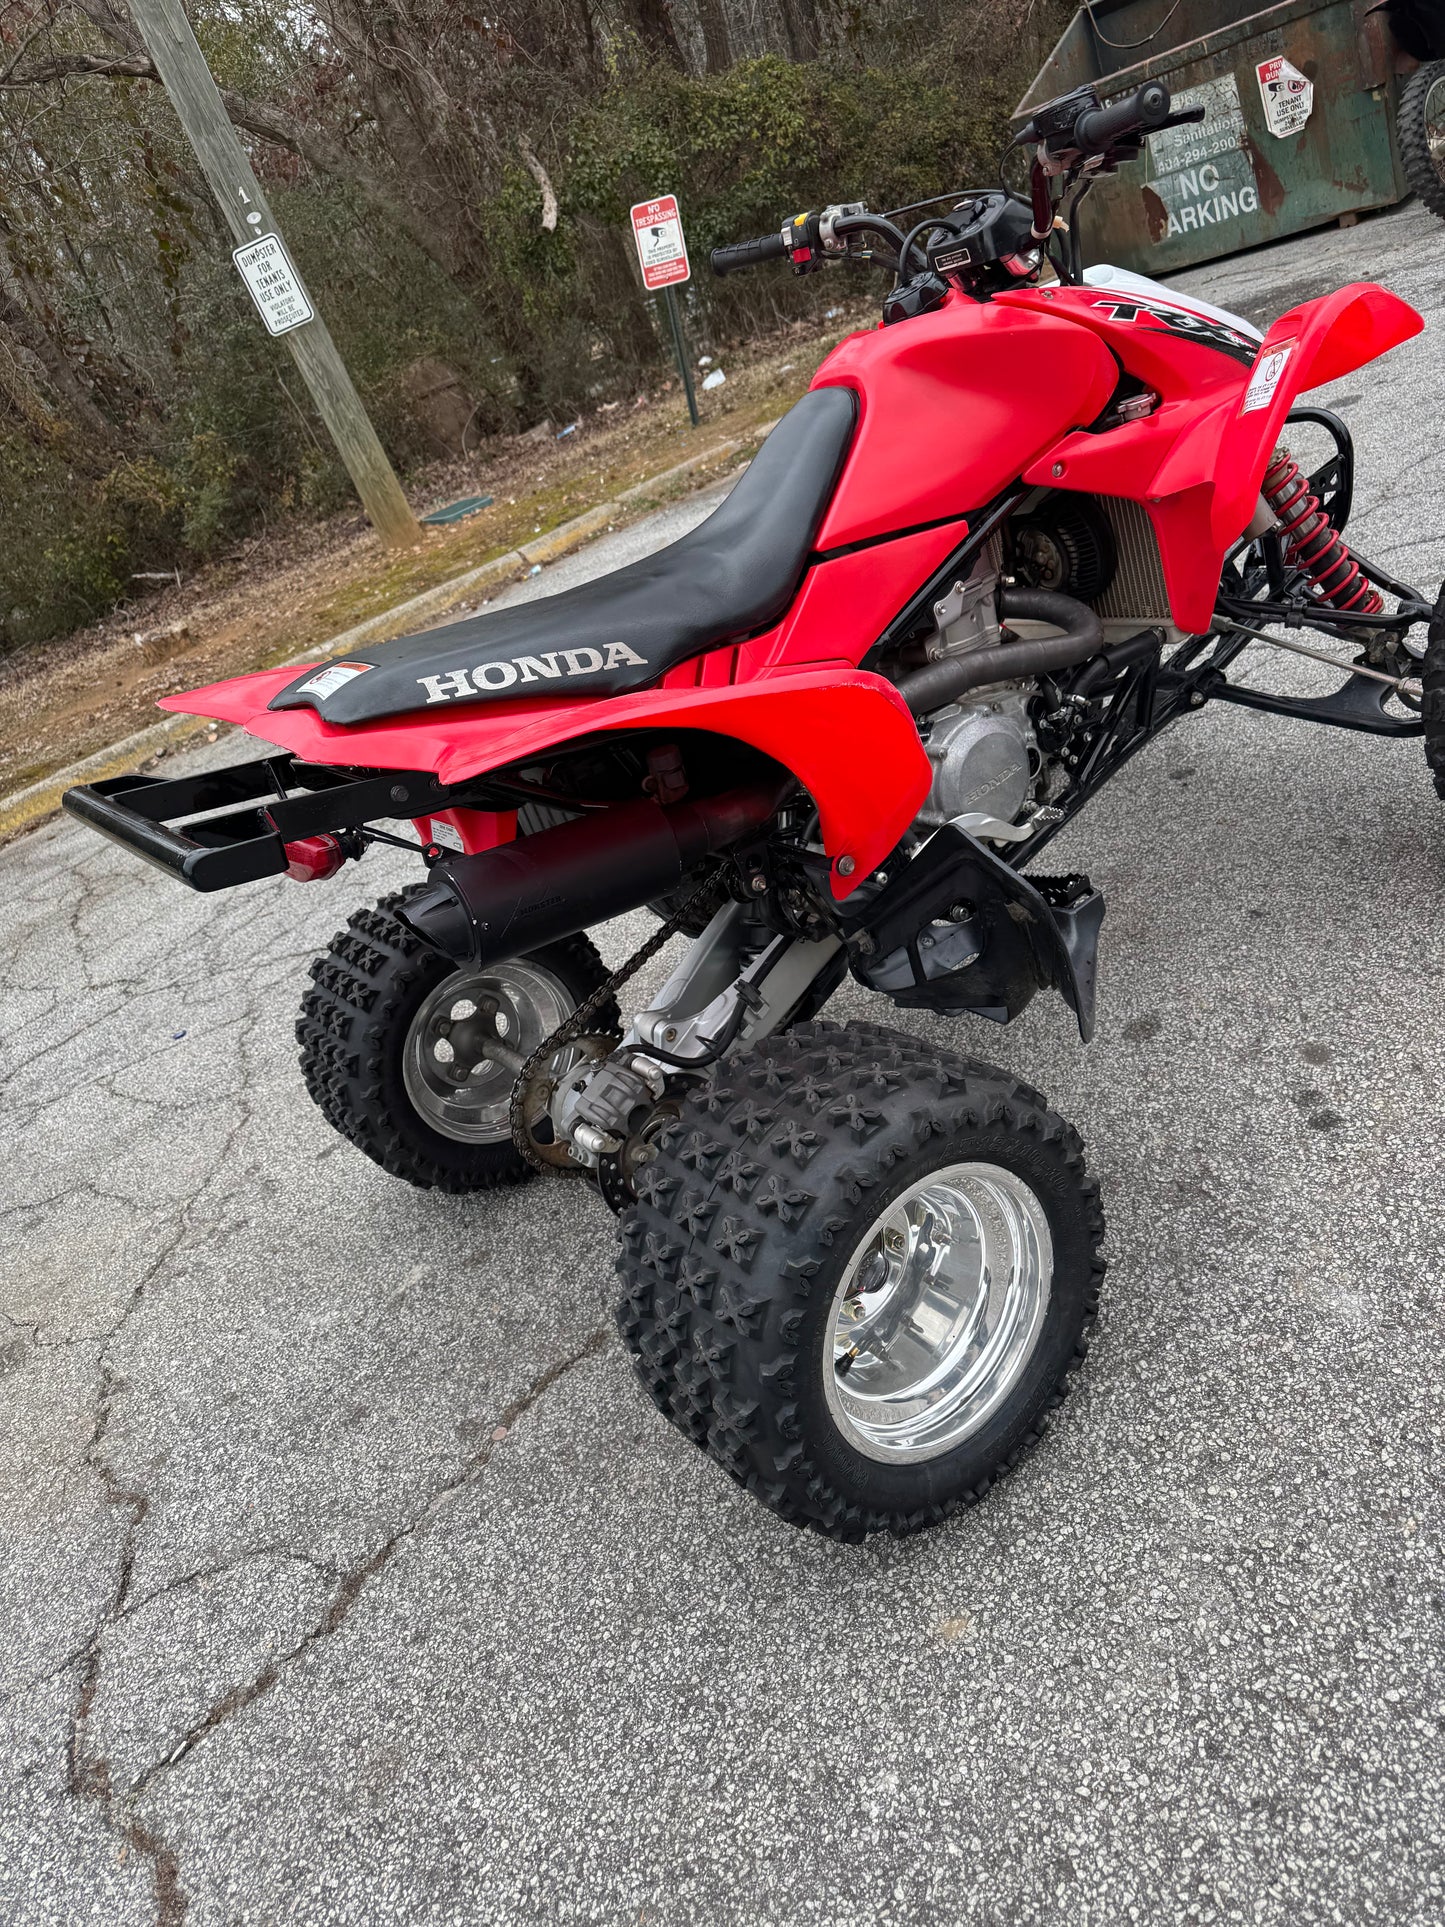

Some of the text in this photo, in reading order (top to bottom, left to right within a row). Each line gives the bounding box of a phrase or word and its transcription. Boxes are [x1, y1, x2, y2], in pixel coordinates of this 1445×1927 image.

[1279, 94, 1302, 108] TENANT
[1276, 108, 1290, 117] USE
[1173, 116, 1239, 147] Sanitation
[1179, 164, 1220, 200] NO
[636, 208, 676, 227] TRESPASSING
[648, 203, 660, 214] NO
[1167, 186, 1258, 238] ARKING
[241, 243, 277, 268] DUMPSTER
[257, 261, 272, 276] FOR
[256, 269, 286, 291] TENANTS
[260, 280, 293, 303] USE ONLY
[270, 296, 296, 312] VIOLATORS
[276, 303, 296, 317] WILL BE
[274, 308, 304, 327] PROSECUTED
[416, 641, 648, 704] HONDA
[965, 762, 1023, 806] HONDA
